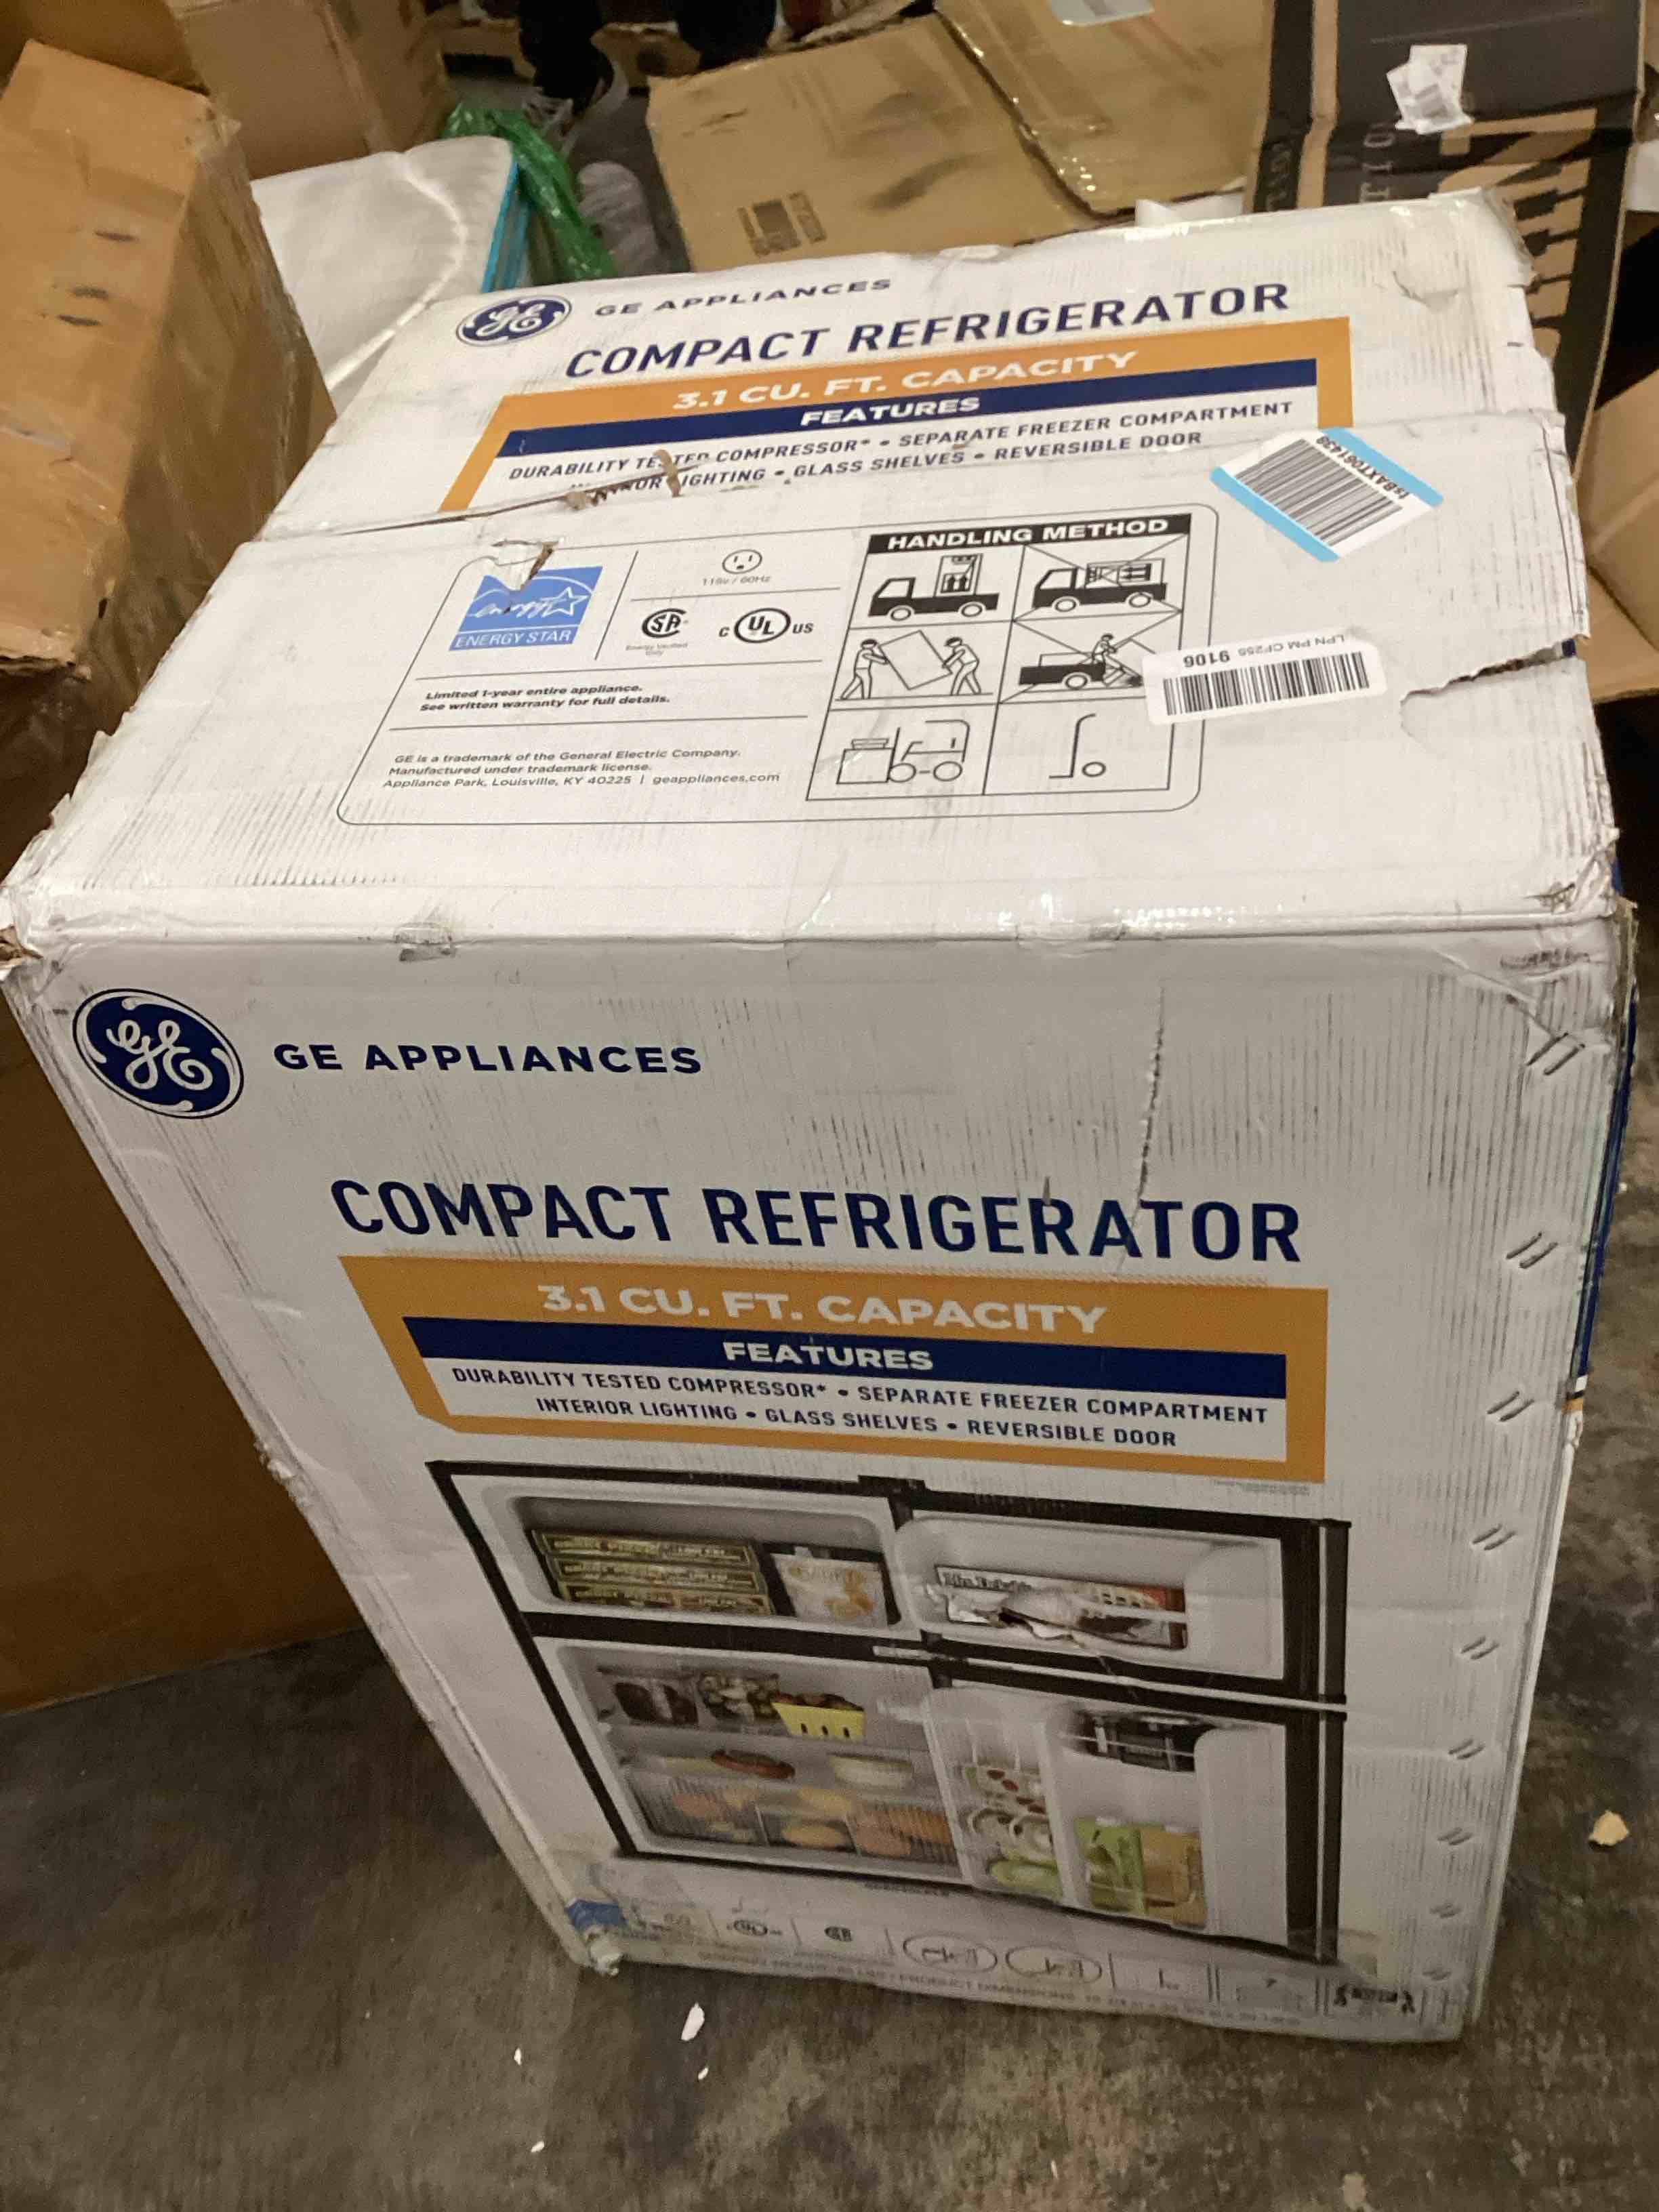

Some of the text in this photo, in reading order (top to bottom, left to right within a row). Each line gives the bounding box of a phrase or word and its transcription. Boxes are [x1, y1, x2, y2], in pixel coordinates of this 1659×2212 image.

[595, 279, 890, 316] GE APPLIANCES
[566, 283, 1289, 378] COMPACT REFRIGERATOR
[672, 350, 1139, 409] 3.1 CU. FT. CAPACITY
[800, 396, 981, 427] FEATURES
[509, 458, 631, 480] DURABILITY
[899, 426, 1008, 447] SEPARATE
[1017, 417, 1111, 437] FREEZER
[1120, 401, 1293, 428] COMPARTMENT
[680, 432, 1202, 487] IGHTING GLASS SHELVES REVERSIBLE DOOR
[887, 518, 1169, 551] HANDLING METHOD
[454, 630, 572, 649] ENERGY STAR
[792, 623, 815, 634] US
[1315, 634, 1345, 647] LPN
[1183, 649, 1231, 668] 9106
[1287, 638, 1311, 650] PM
[419, 694, 671, 712] See written warranty for full details.
[426, 689, 478, 701] Limited
[526, 687, 567, 696] entire
[570, 684, 643, 696] appliance.
[388, 762, 652, 776] Manufactured under trademark license.
[394, 754, 414, 763] GE
[417, 754, 428, 763] is
[443, 753, 511, 763] trademark
[515, 752, 529, 761] of
[533, 752, 555, 761] the
[559, 751, 612, 760] General
[615, 749, 668, 760] Electric
[672, 748, 741, 758] Company.
[382, 779, 451, 789] Appliance
[491, 777, 559, 787] Louisville,
[563, 777, 581, 786] KY
[587, 775, 632, 785] 40225
[652, 773, 780, 786] geappliances.com
[274, 1044, 702, 1074] GE APPLIANCES
[330, 1179, 1300, 1263] COMPACT REFRIGERATOR
[537, 1284, 1107, 1334] 3.1 CU. FT. CAPACITY
[723, 1341, 934, 1371] FEATURES
[451, 1367, 576, 1388] DURABILITY
[582, 1372, 661, 1391] TESTED
[858, 1386, 971, 1408] SEPARATE
[981, 1392, 1078, 1414] FREEZER
[1087, 1398, 1268, 1424] COMPARTMENT
[537, 1397, 1177, 1448] INTERIOR LIGHTING GLASS SHELVES REVERSIBLE DOOR
